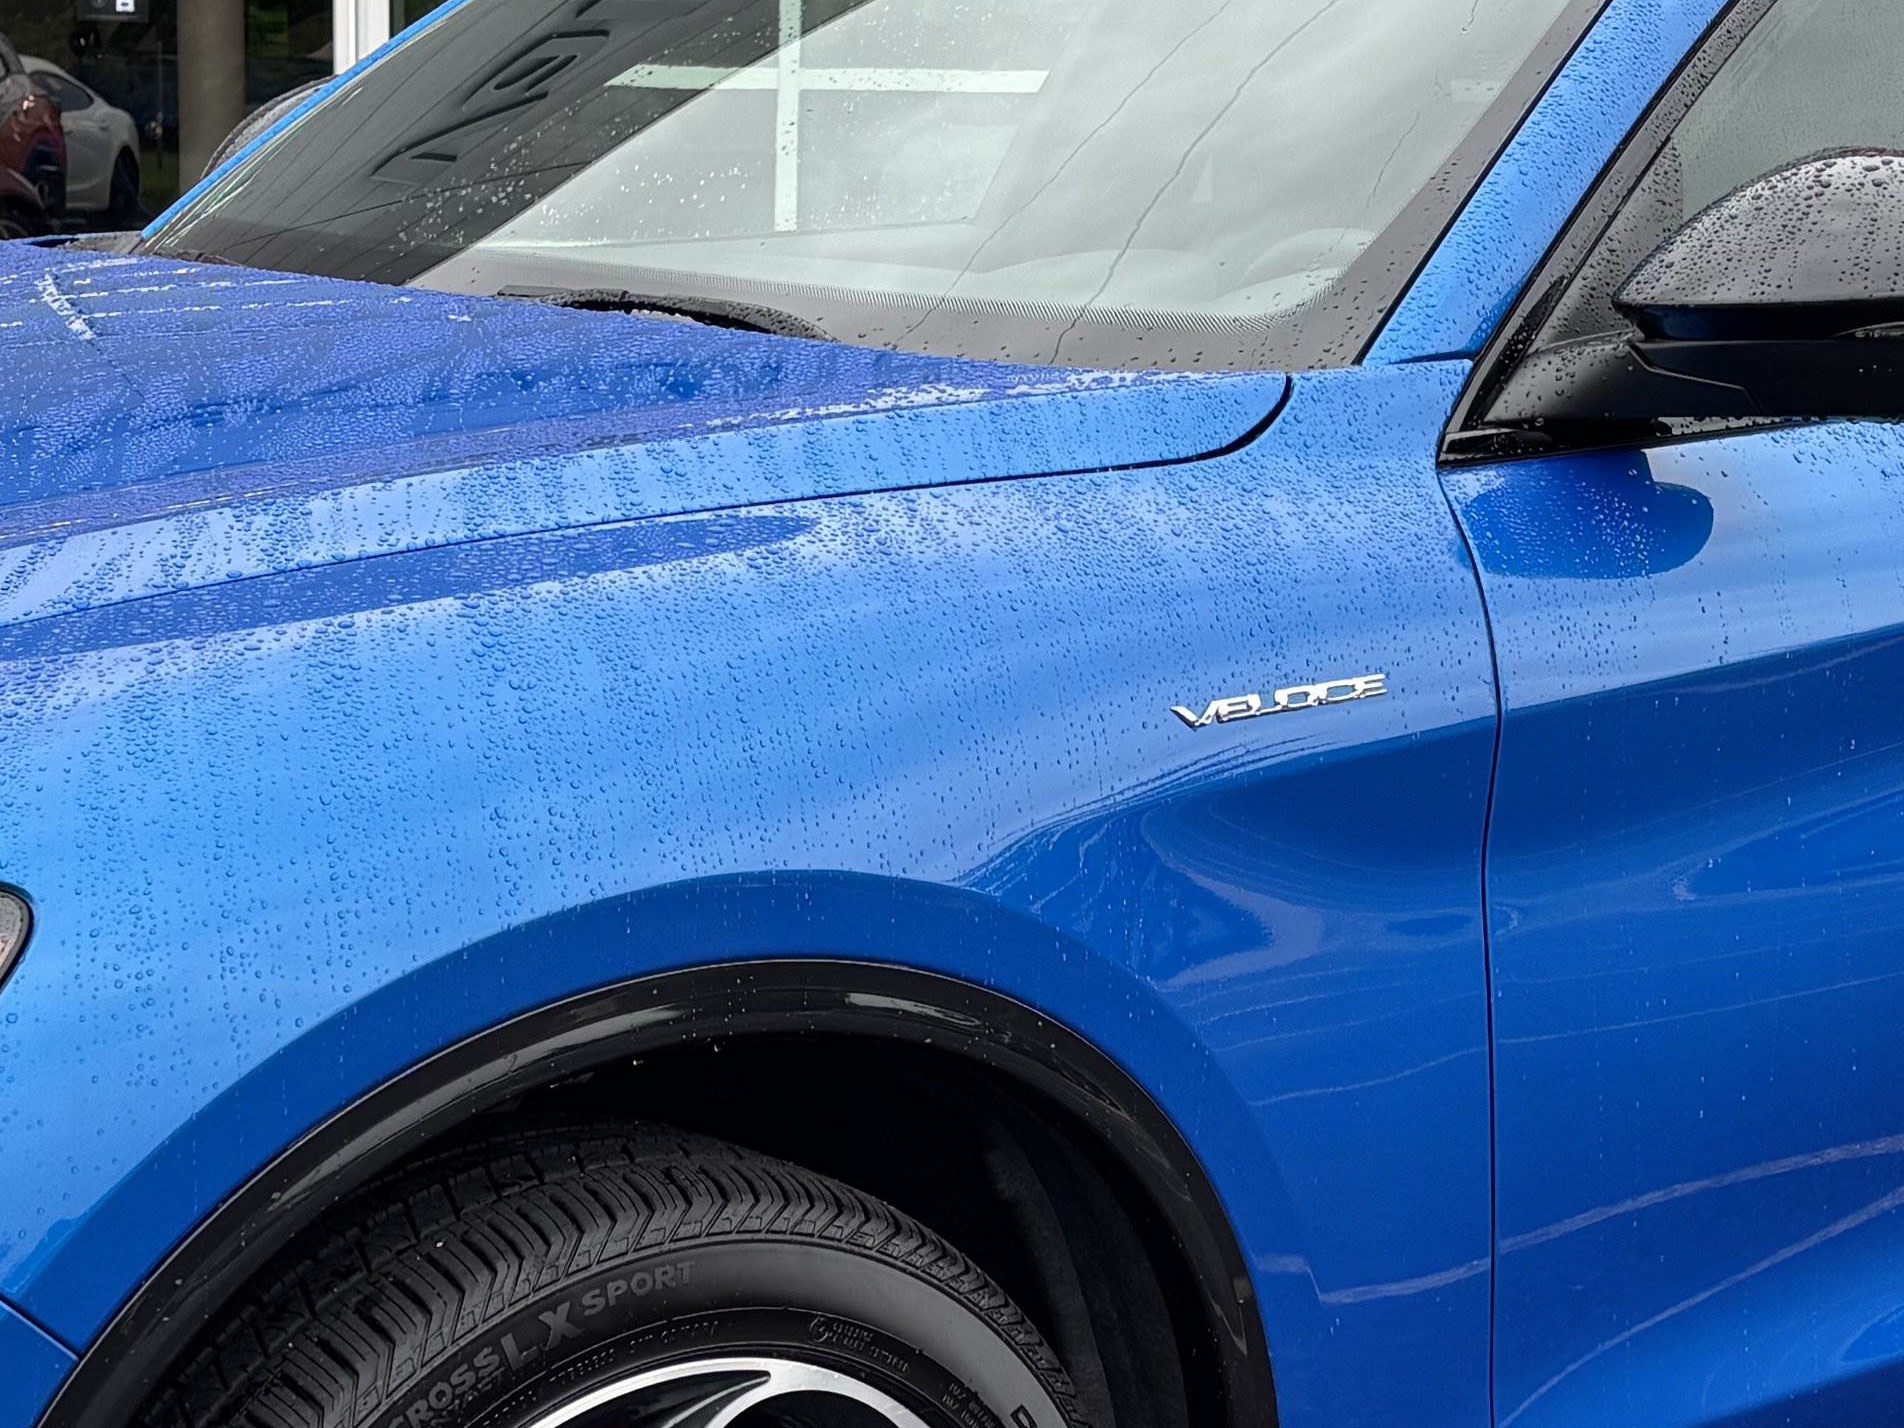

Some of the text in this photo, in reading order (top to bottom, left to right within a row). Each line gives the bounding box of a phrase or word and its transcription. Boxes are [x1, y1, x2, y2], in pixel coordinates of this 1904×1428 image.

[1170, 673, 1389, 731] VELOCE
[503, 1298, 584, 1370] LX
[583, 1260, 696, 1316] SPORT
